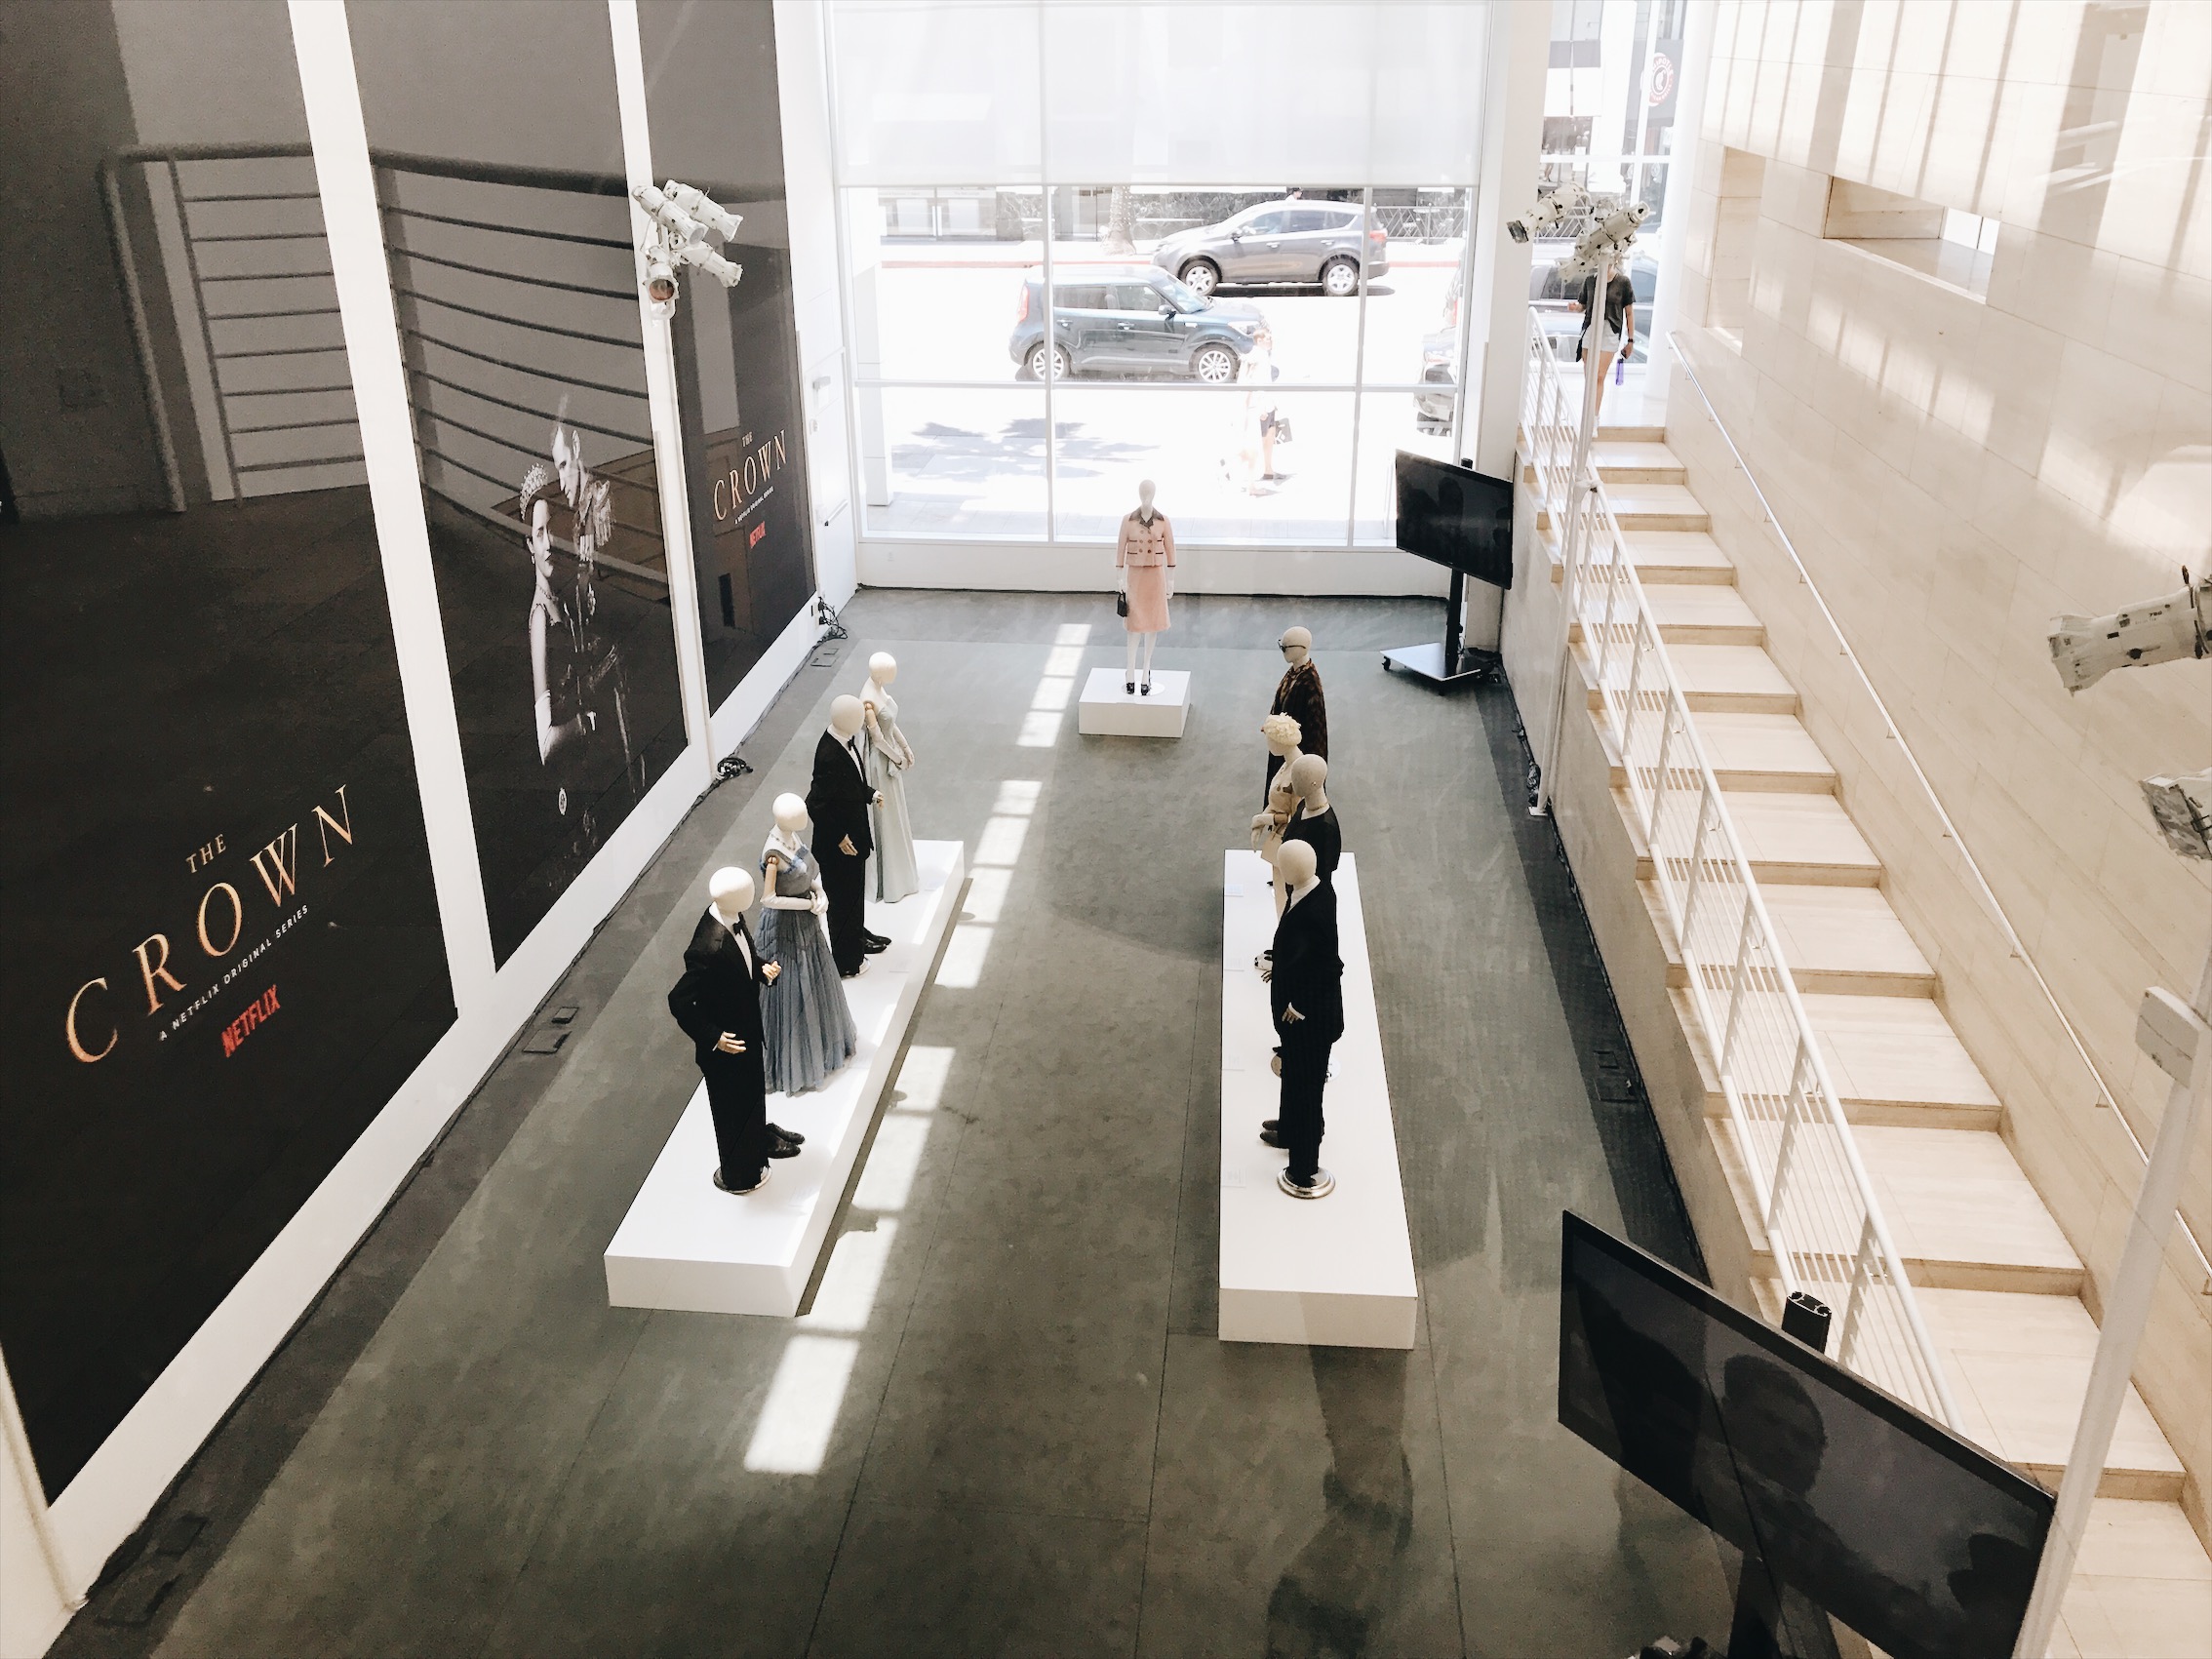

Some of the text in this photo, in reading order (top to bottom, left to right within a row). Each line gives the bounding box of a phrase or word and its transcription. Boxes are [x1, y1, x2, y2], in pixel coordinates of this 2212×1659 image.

[714, 429, 786, 521] CROWN
[742, 431, 753, 448] THE
[185, 833, 226, 874] THE
[65, 784, 353, 1063] CROWN
[159, 904, 309, 1042] A NETFLIX ORIGINAL SERIES
[221, 983, 281, 1058] NETFLIX
